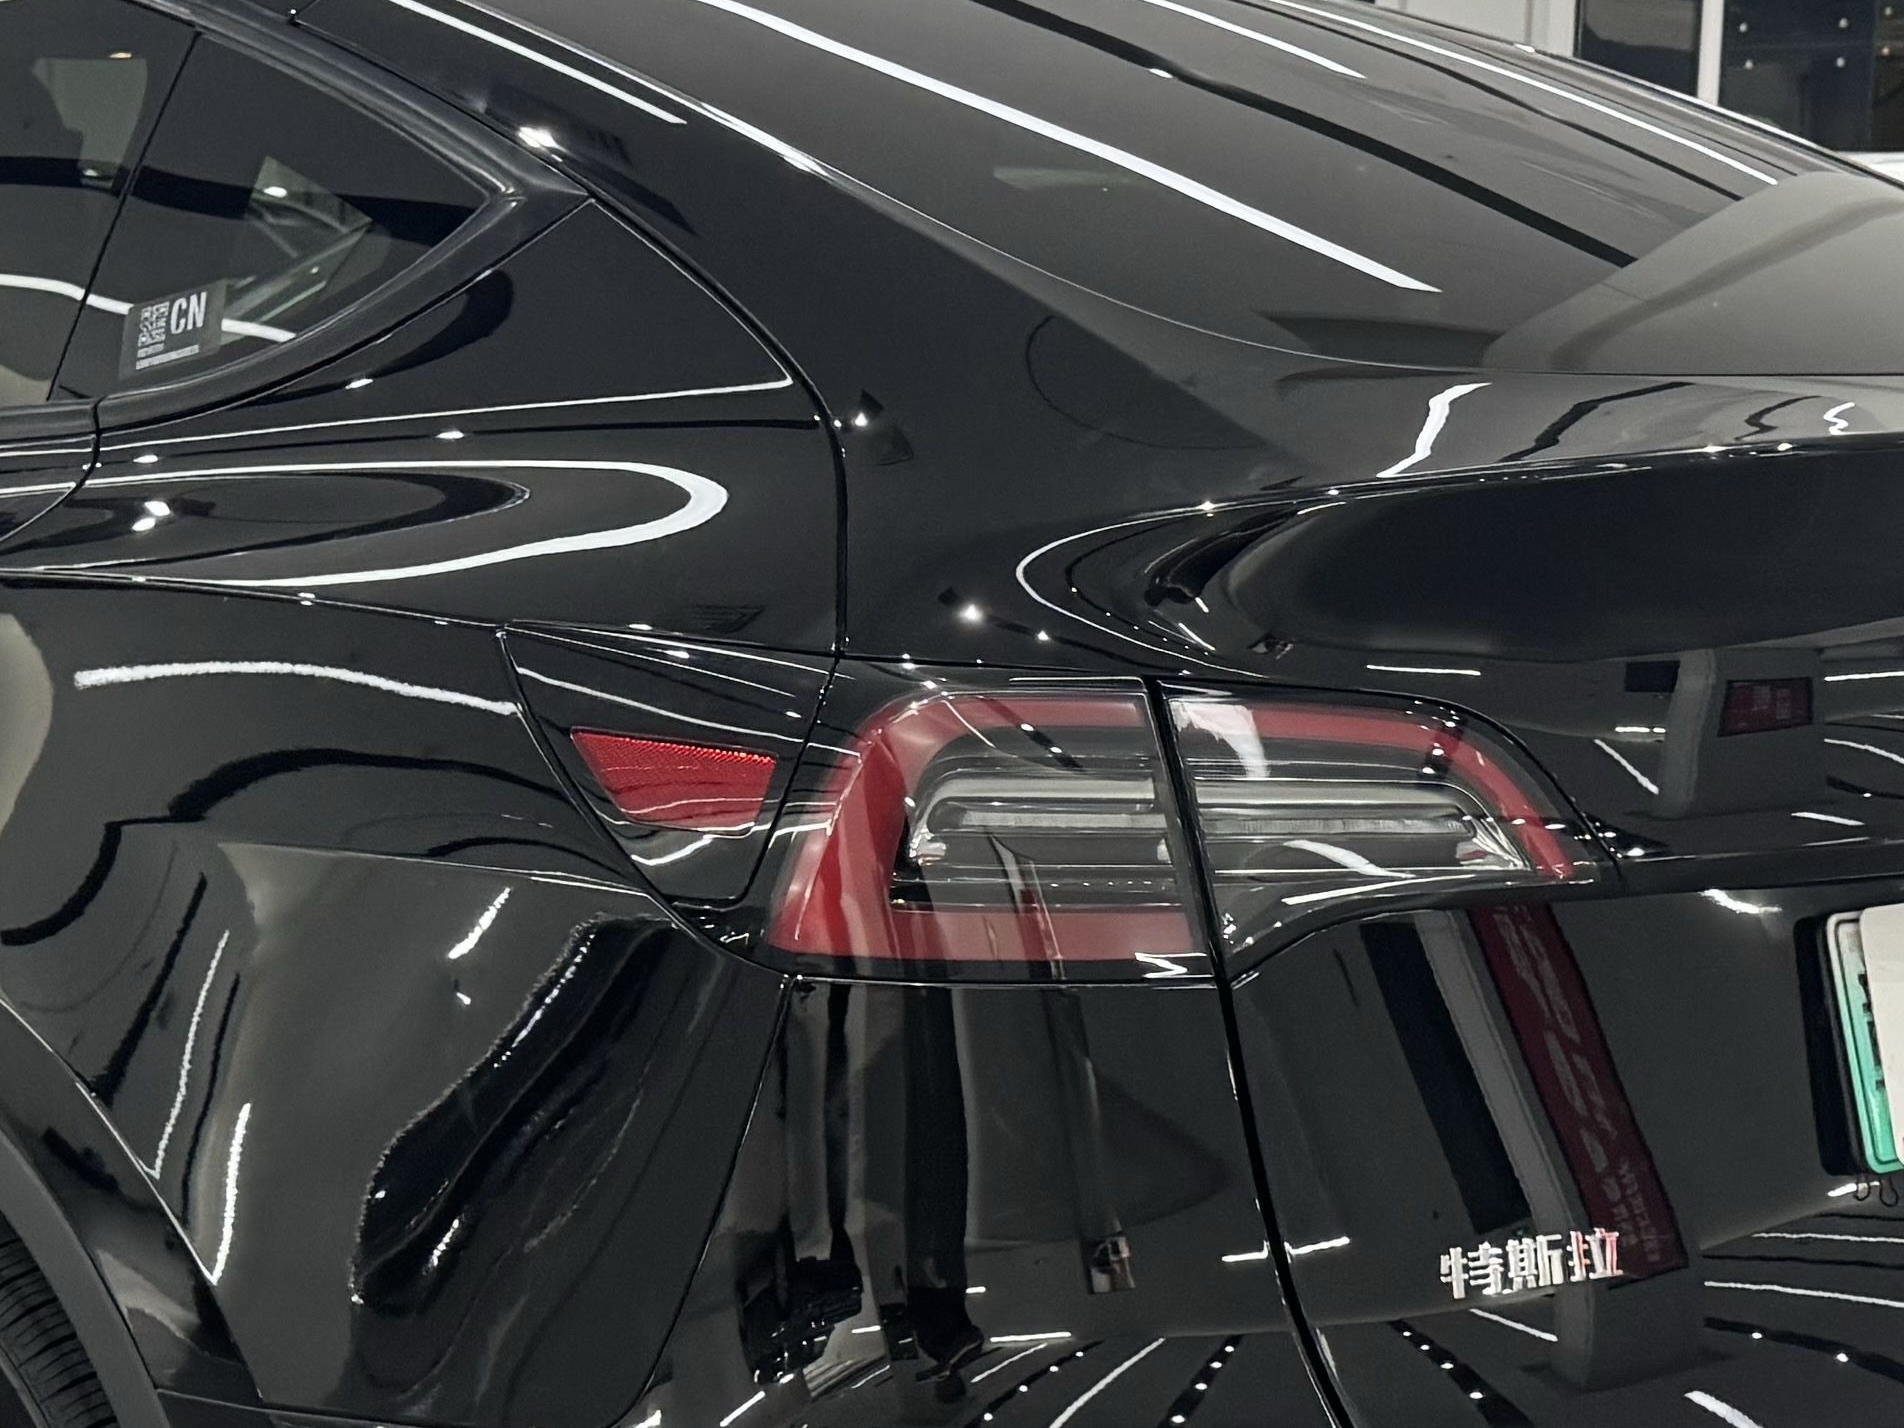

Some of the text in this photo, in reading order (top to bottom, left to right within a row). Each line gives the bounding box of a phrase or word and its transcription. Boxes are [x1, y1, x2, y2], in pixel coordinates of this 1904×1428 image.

[170, 291, 208, 335] CN
[1440, 1227, 1624, 1300] 特斯拉
